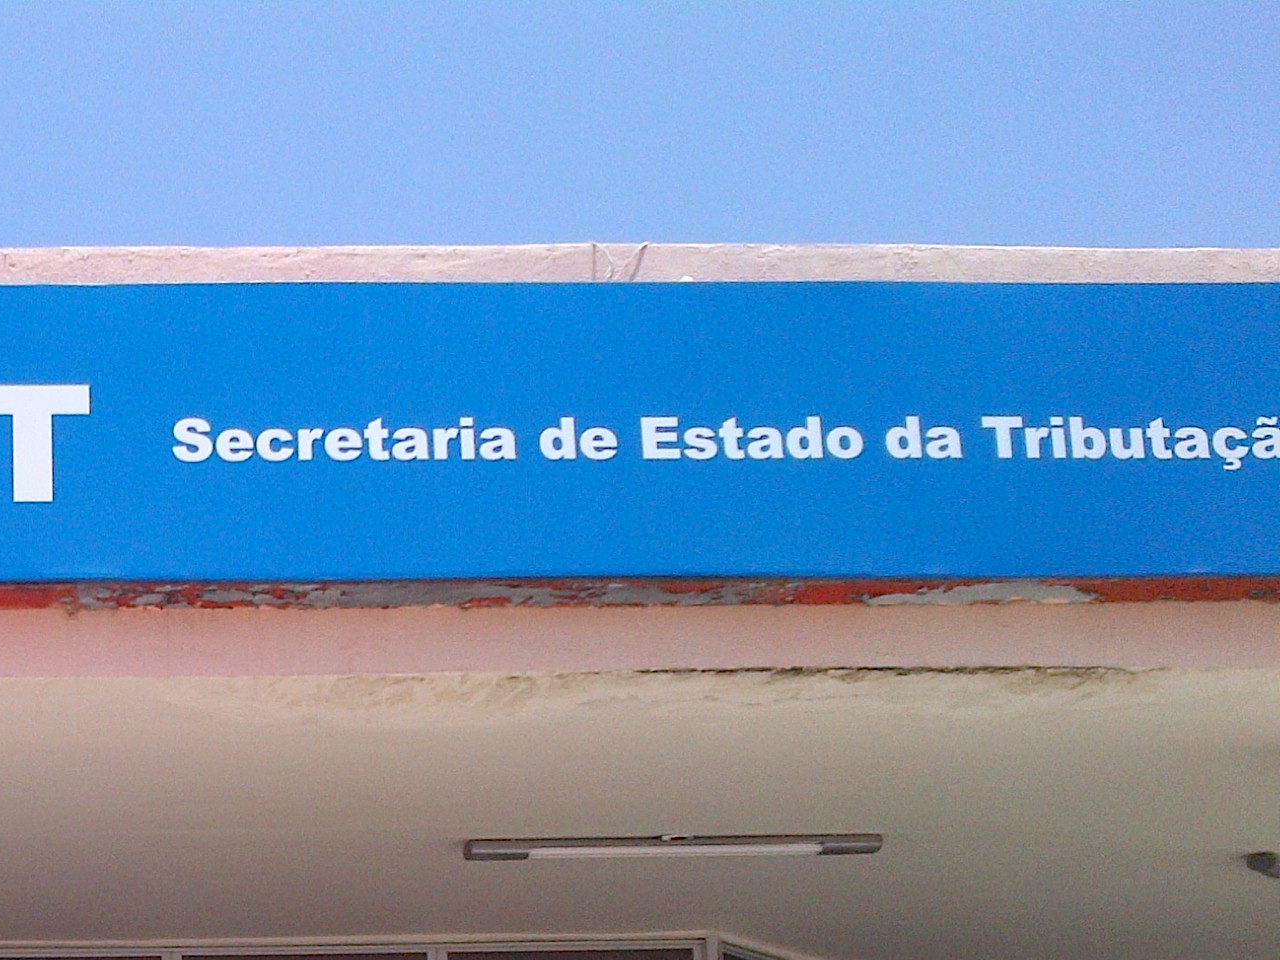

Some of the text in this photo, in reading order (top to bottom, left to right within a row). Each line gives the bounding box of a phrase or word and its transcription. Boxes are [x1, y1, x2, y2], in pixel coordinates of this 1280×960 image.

[172, 415, 1280, 470] Secretaria de Estado da Tributaçã
